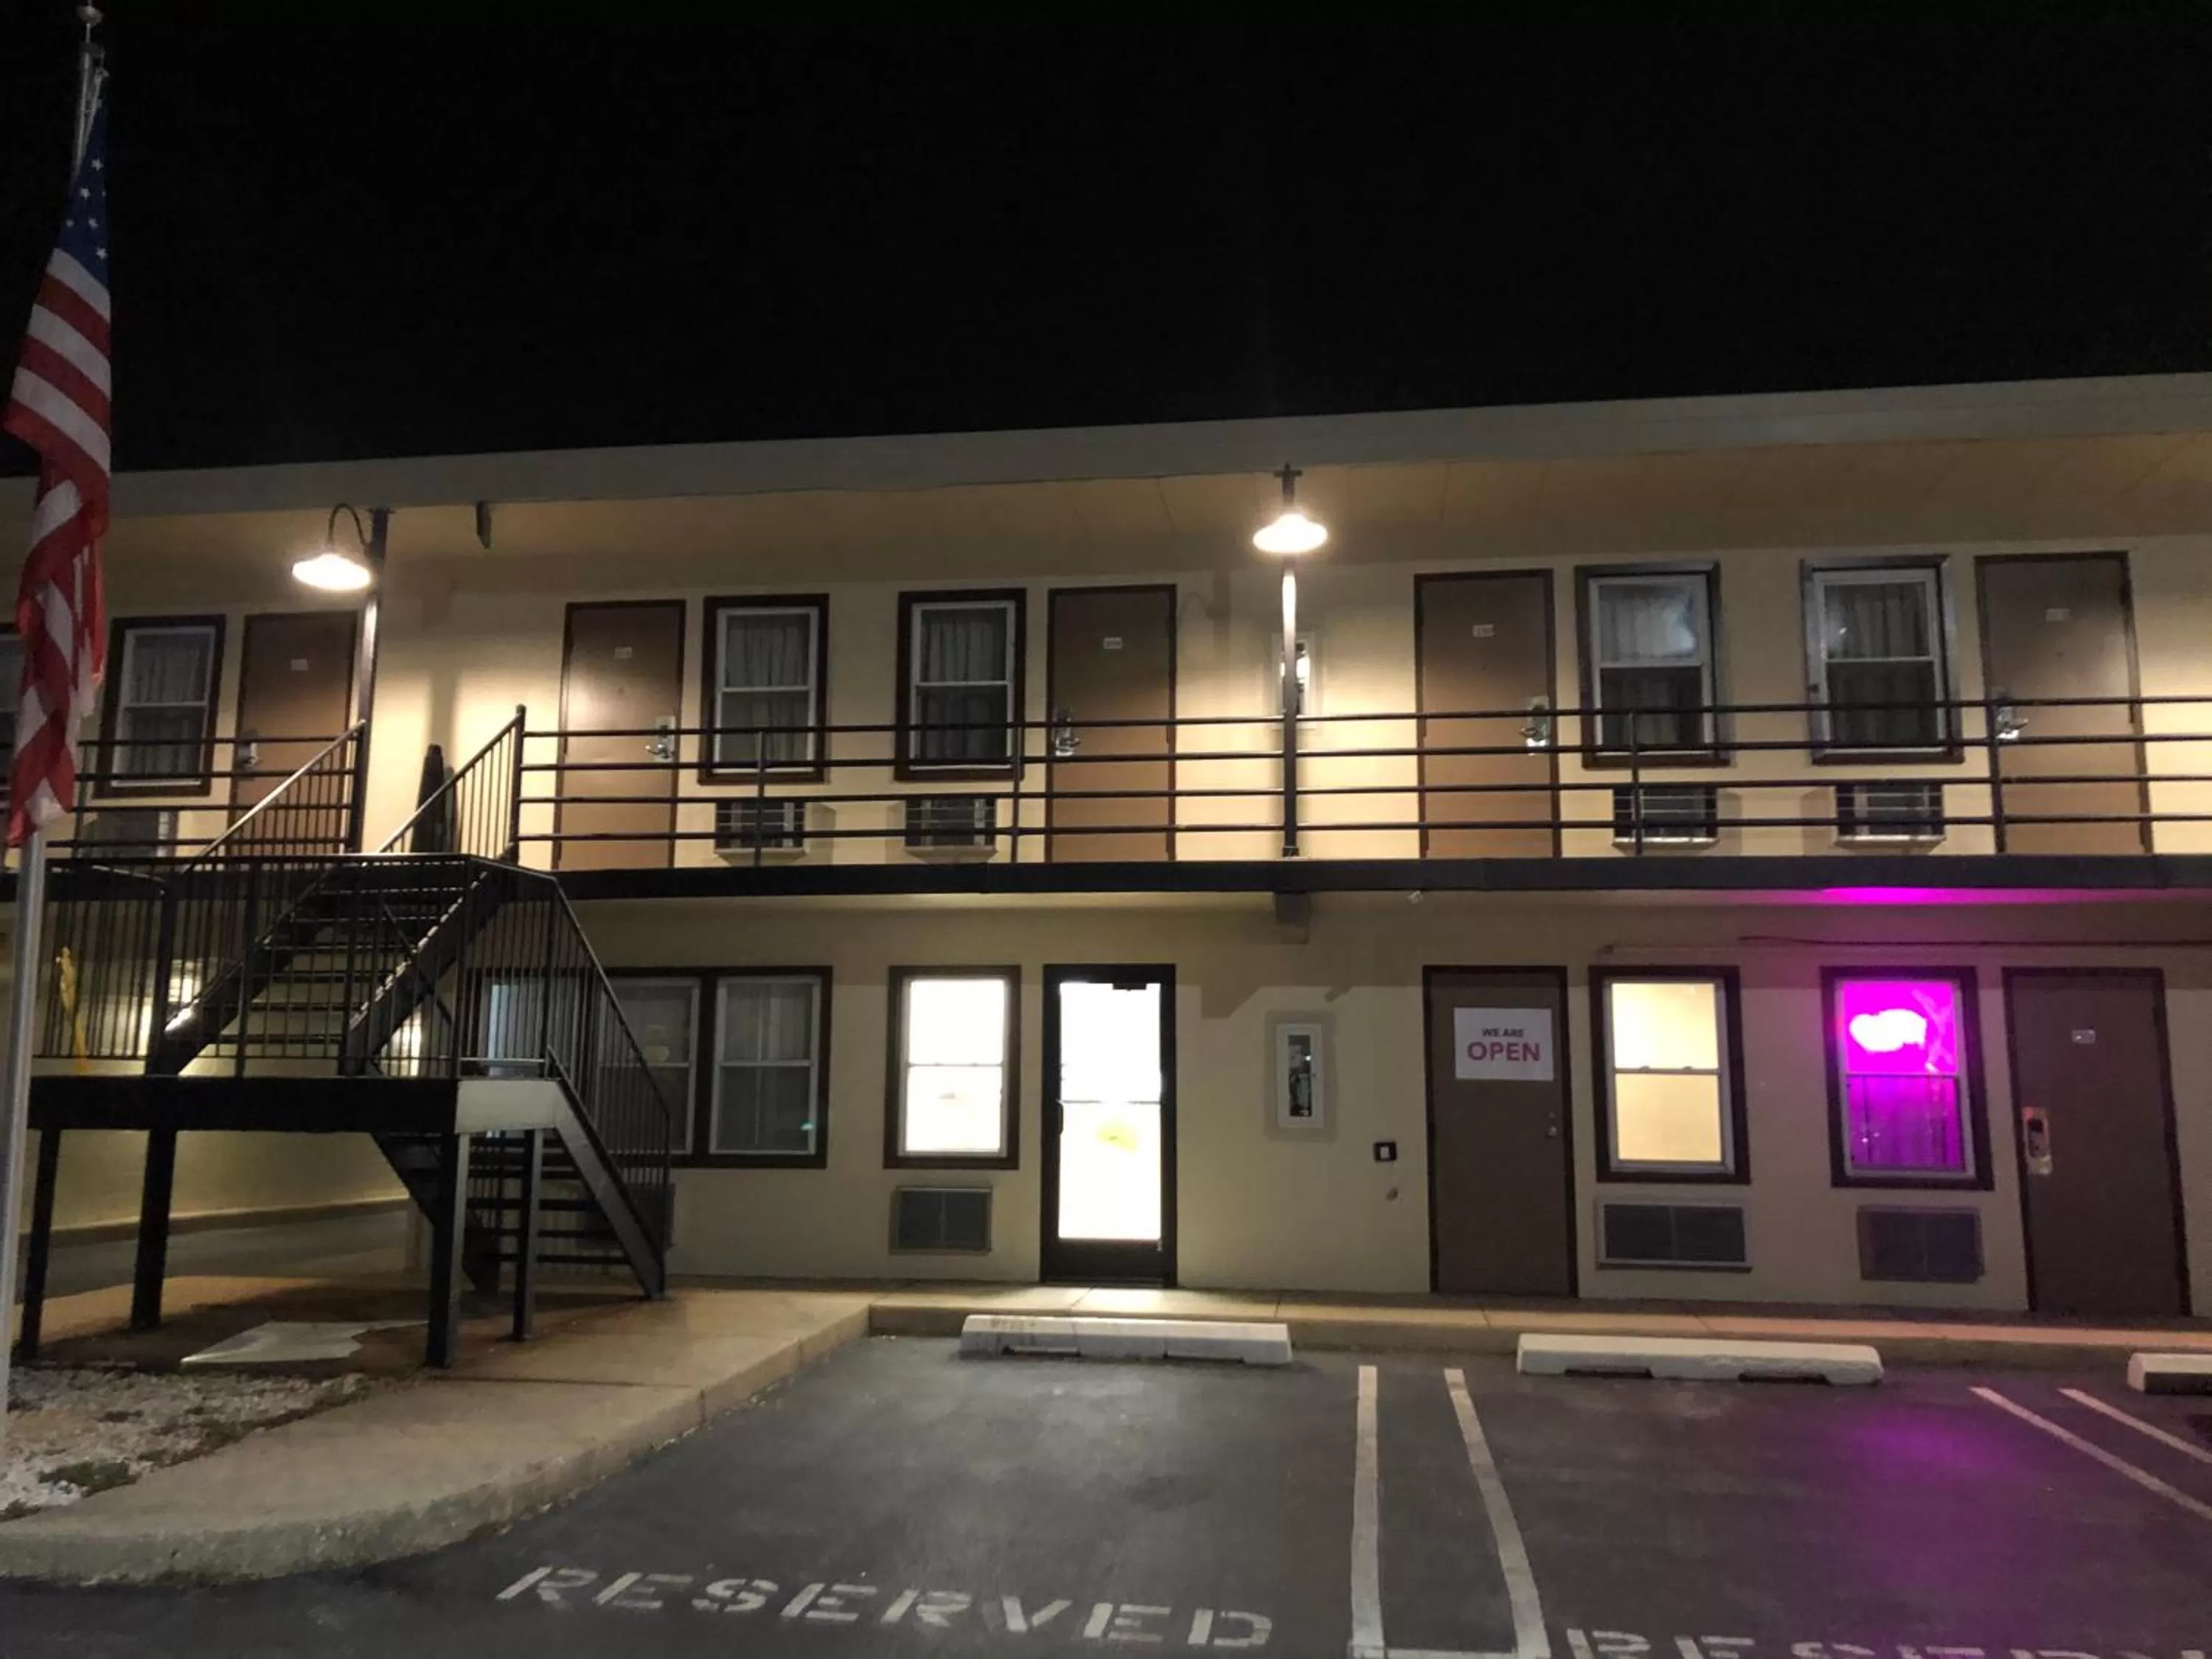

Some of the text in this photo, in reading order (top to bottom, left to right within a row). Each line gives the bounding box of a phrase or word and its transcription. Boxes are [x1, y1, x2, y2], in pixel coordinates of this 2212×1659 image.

[1483, 1029, 1523, 1037] WE ARE
[1467, 1042, 1540, 1062] OPEN
[495, 1565, 1273, 1647] RESERVED
